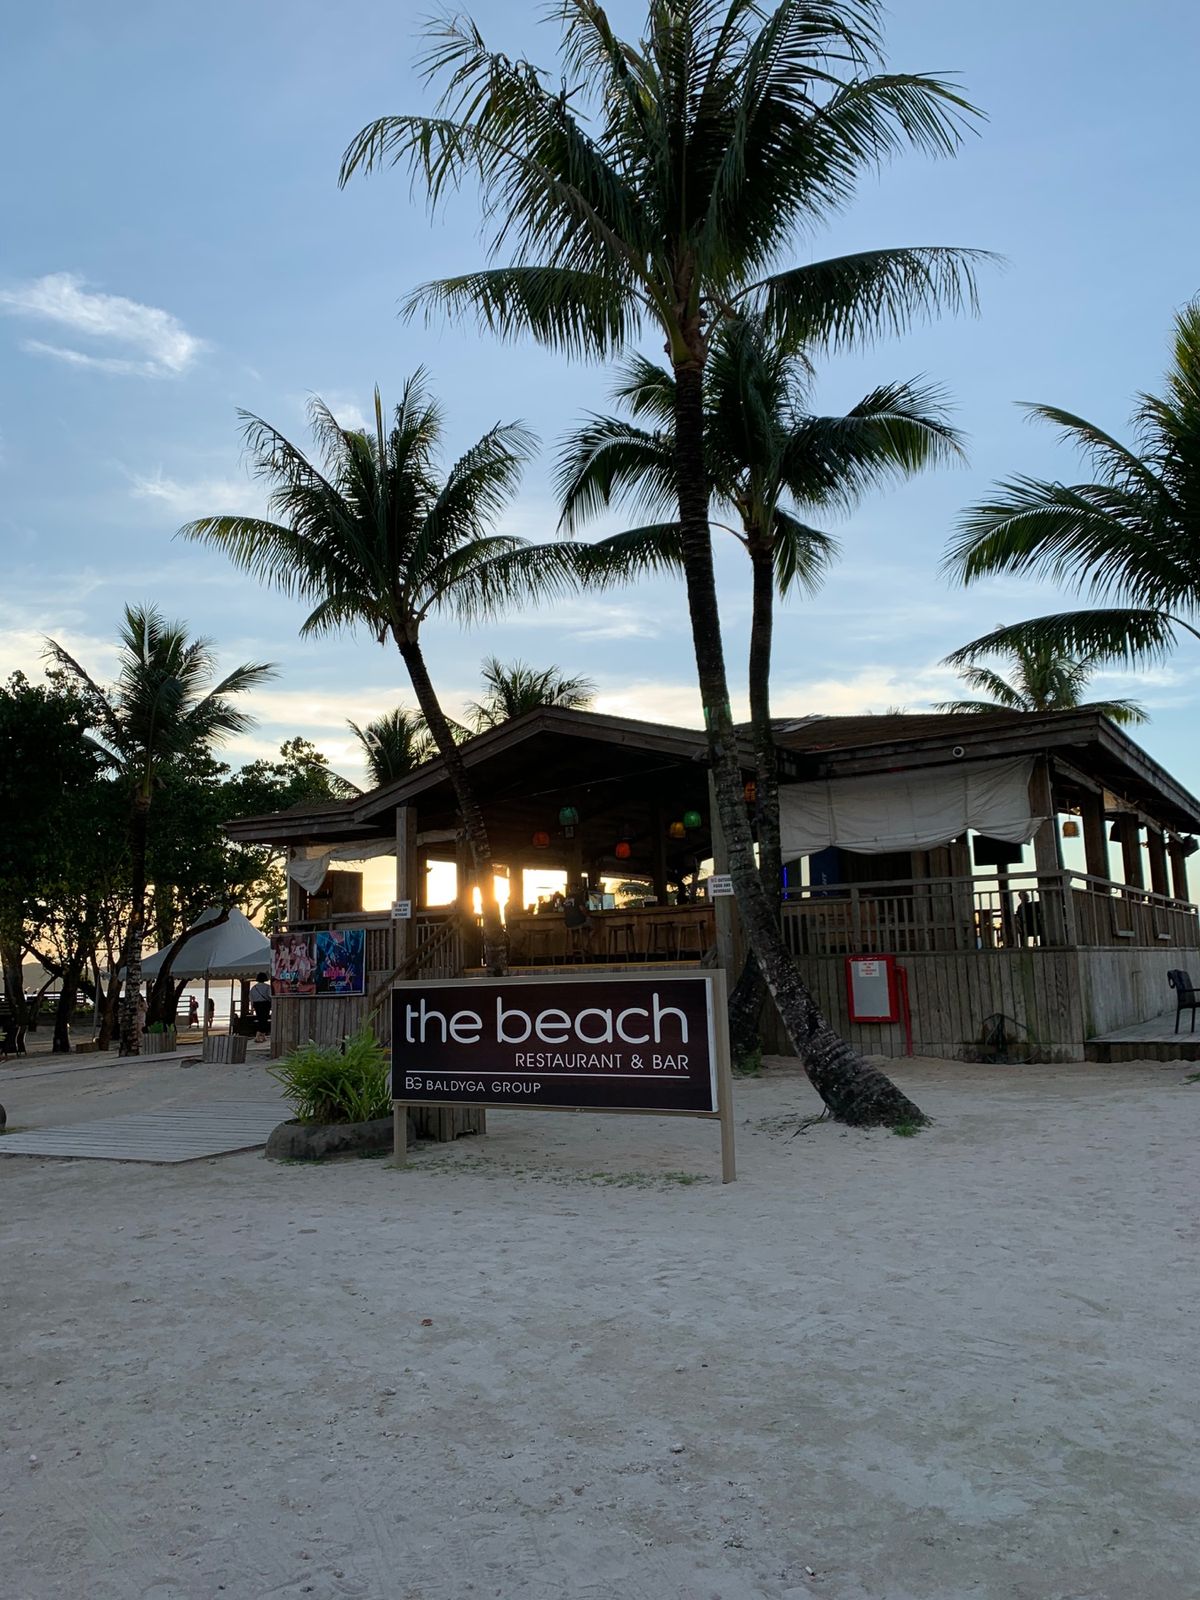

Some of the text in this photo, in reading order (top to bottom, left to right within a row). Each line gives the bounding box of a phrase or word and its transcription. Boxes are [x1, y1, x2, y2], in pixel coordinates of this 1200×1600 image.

[405, 992, 689, 1045] the beach
[515, 1052, 689, 1070] RESTAURANT & BAR
[426, 1079, 486, 1092] BALDYGA
[491, 1081, 541, 1094] GROUP
